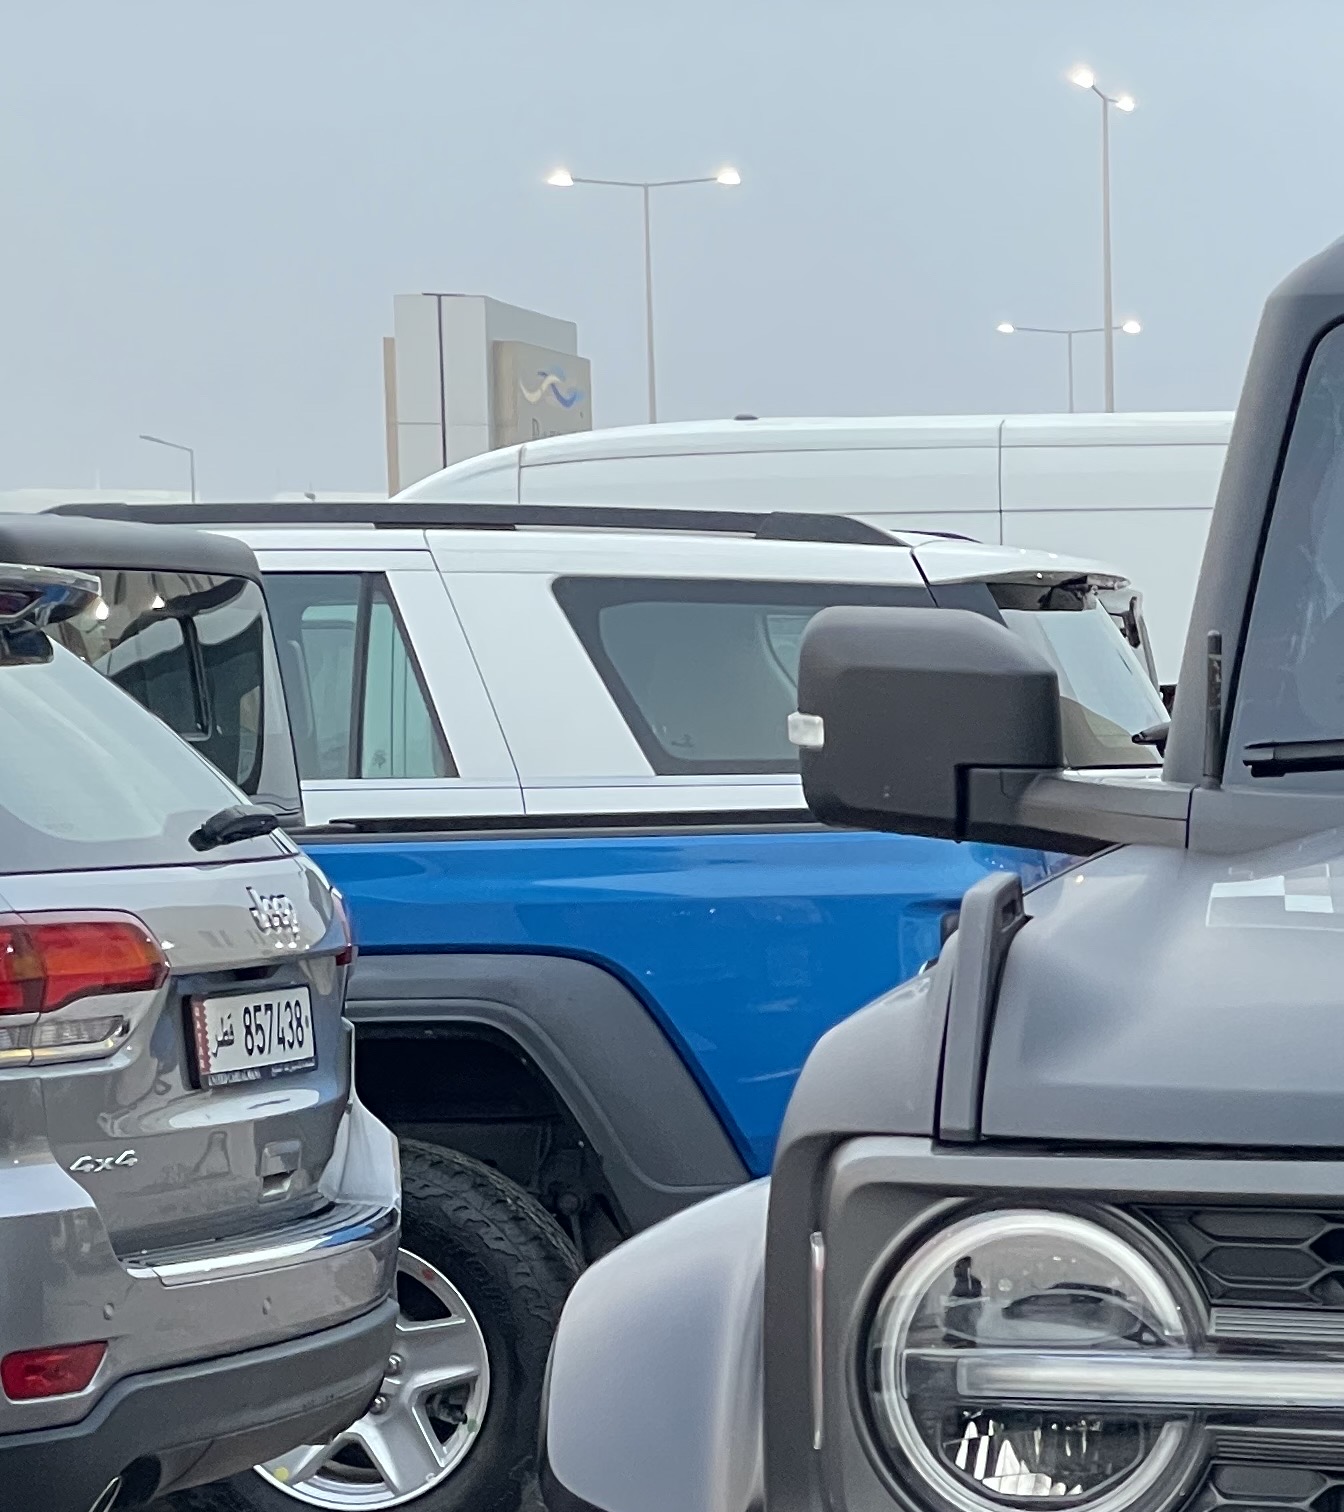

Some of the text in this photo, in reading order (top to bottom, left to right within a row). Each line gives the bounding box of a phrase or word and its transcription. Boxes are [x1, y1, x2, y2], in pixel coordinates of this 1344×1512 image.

[245, 886, 299, 939] Jeep
[212, 1013, 235, 1058] قطر
[243, 999, 305, 1056] 857438
